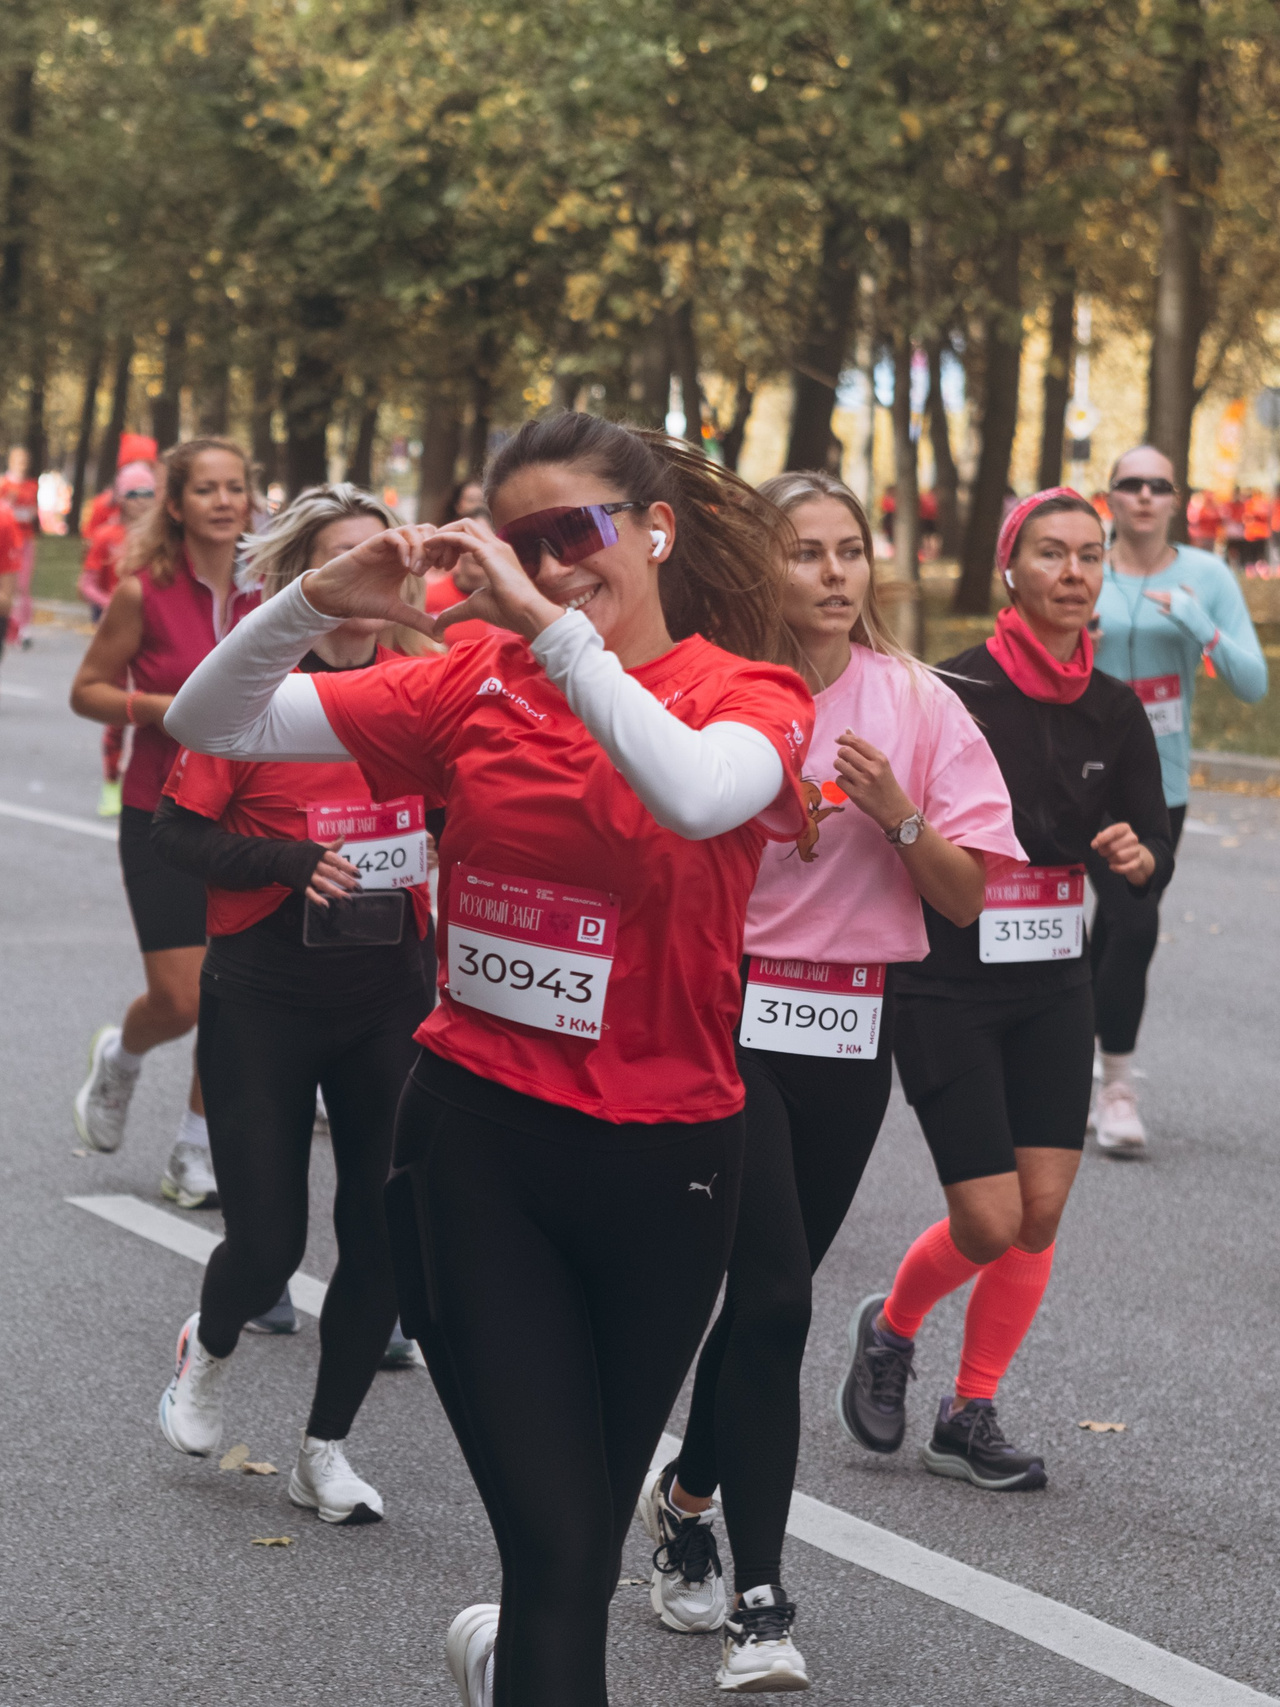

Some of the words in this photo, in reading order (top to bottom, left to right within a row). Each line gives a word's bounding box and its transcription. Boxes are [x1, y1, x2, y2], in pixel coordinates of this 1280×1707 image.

[459, 892, 509, 925] РОЗОВЫЙ
[509, 904, 544, 931] ЗАБЕГ
[582, 918, 600, 937] D
[995, 919, 1063, 942] 31355
[458, 943, 593, 1003] 30943
[855, 969, 864, 982] C
[555, 1014, 565, 1028] 3
[757, 999, 858, 1033] 31900
[869, 1007, 878, 1044] МОСКВА
[836, 1043, 843, 1054] 3
